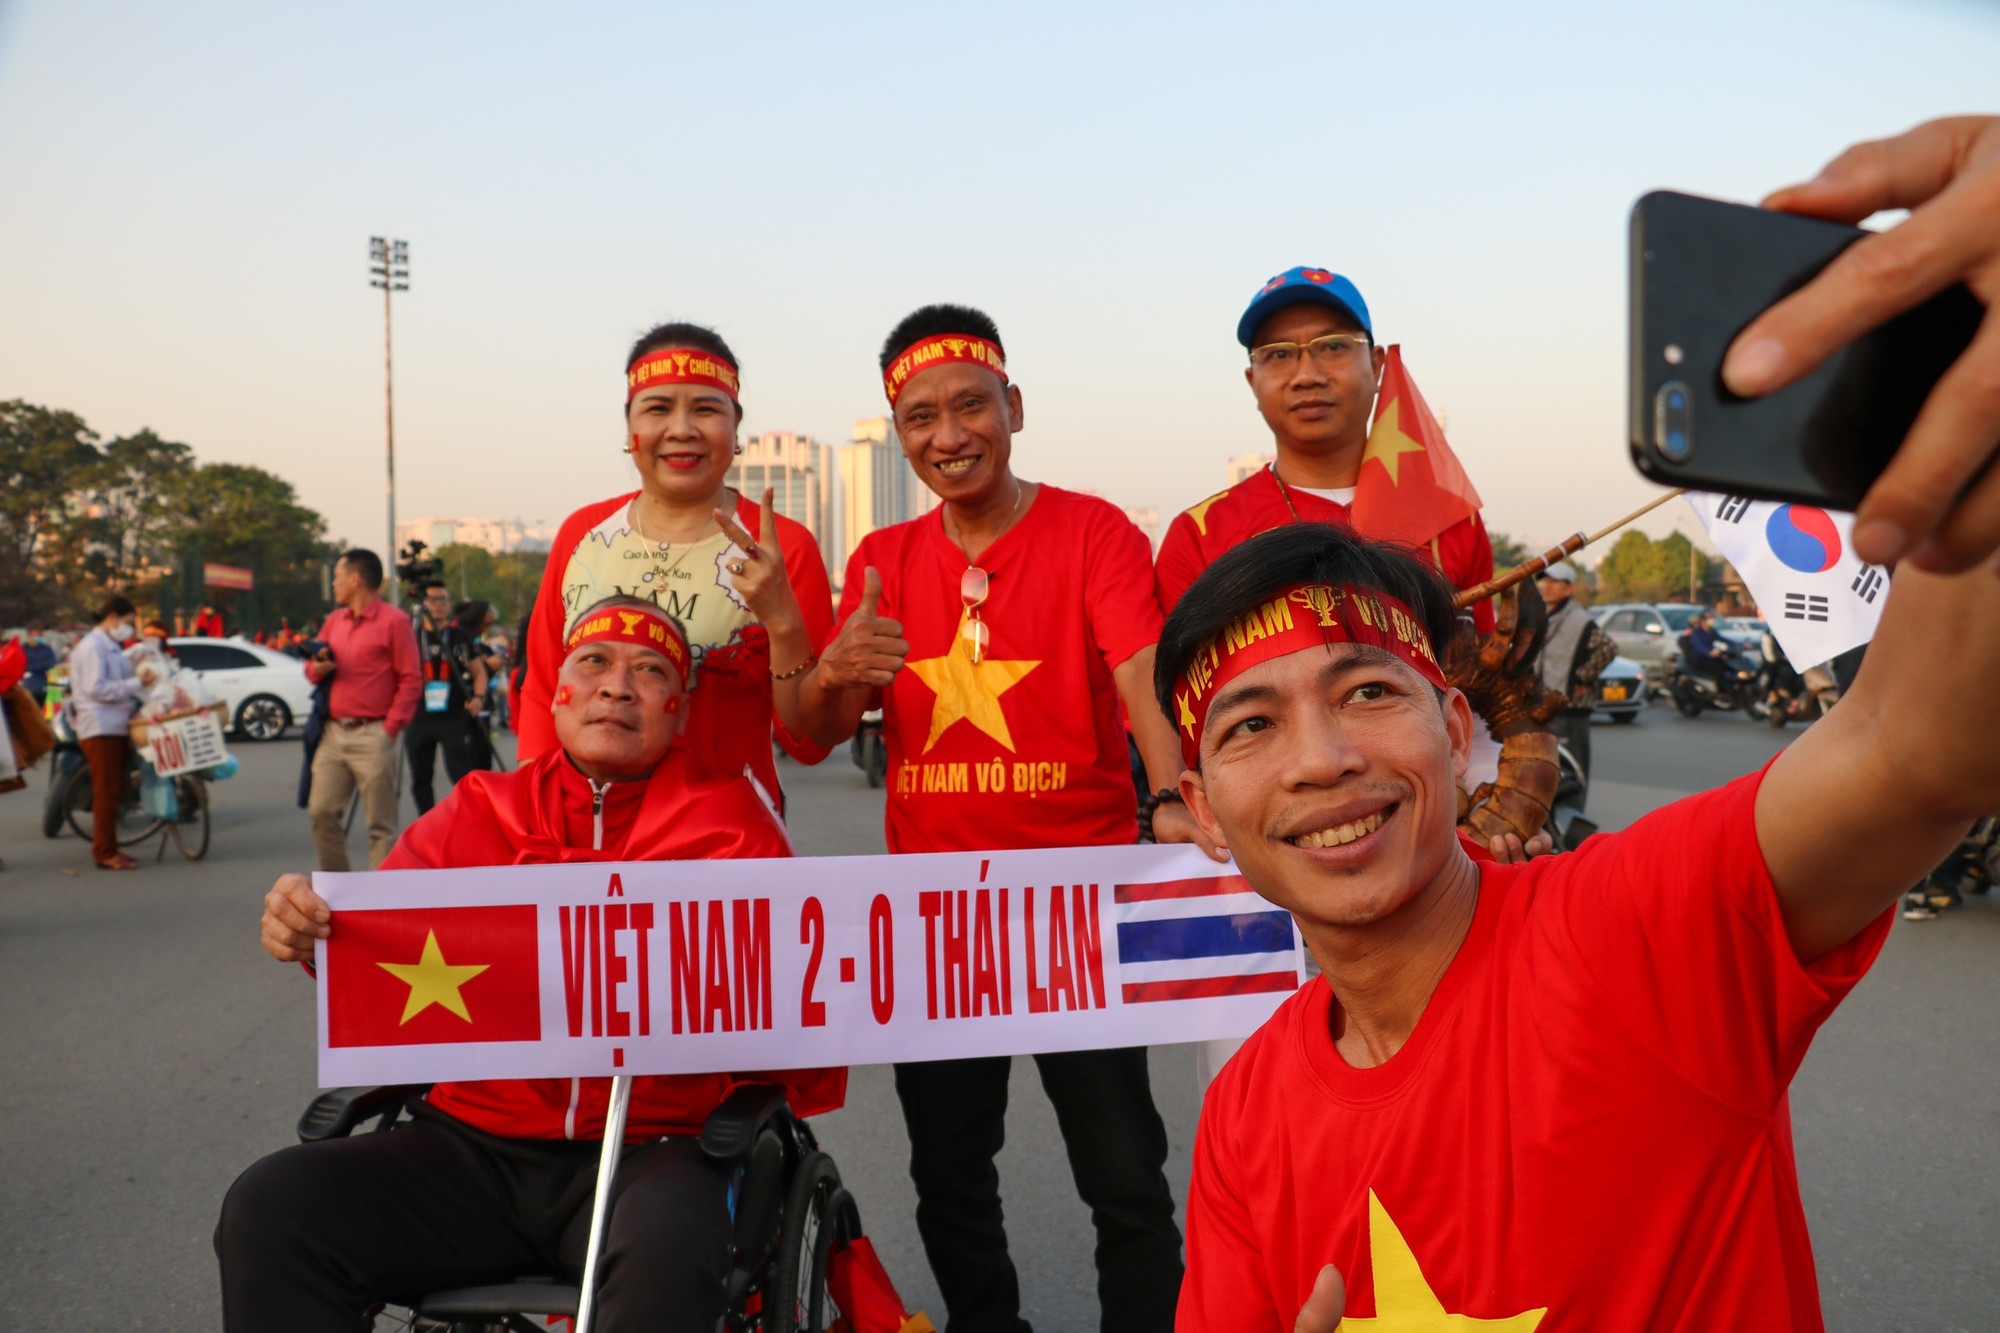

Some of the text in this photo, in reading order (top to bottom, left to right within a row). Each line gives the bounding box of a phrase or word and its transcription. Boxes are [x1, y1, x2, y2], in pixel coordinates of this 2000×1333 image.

[912, 342, 945, 366] NAM
[969, 341, 986, 362] VÔ
[651, 358, 672, 377] NAM
[623, 549, 641, 560] Cao
[672, 567, 692, 580] Kan
[582, 617, 612, 638] NAM
[1223, 597, 1295, 656] NAM
[922, 762, 969, 793] NAM
[975, 756, 1006, 793] VÔ
[1012, 761, 1067, 799] ĐỊCH
[558, 873, 654, 1068] VIỆT
[669, 898, 773, 1035] NAM
[800, 896, 827, 1027] 2
[868, 893, 895, 1026] 0
[919, 859, 1013, 1021] THÁI
[1023, 883, 1107, 1014] LAN
